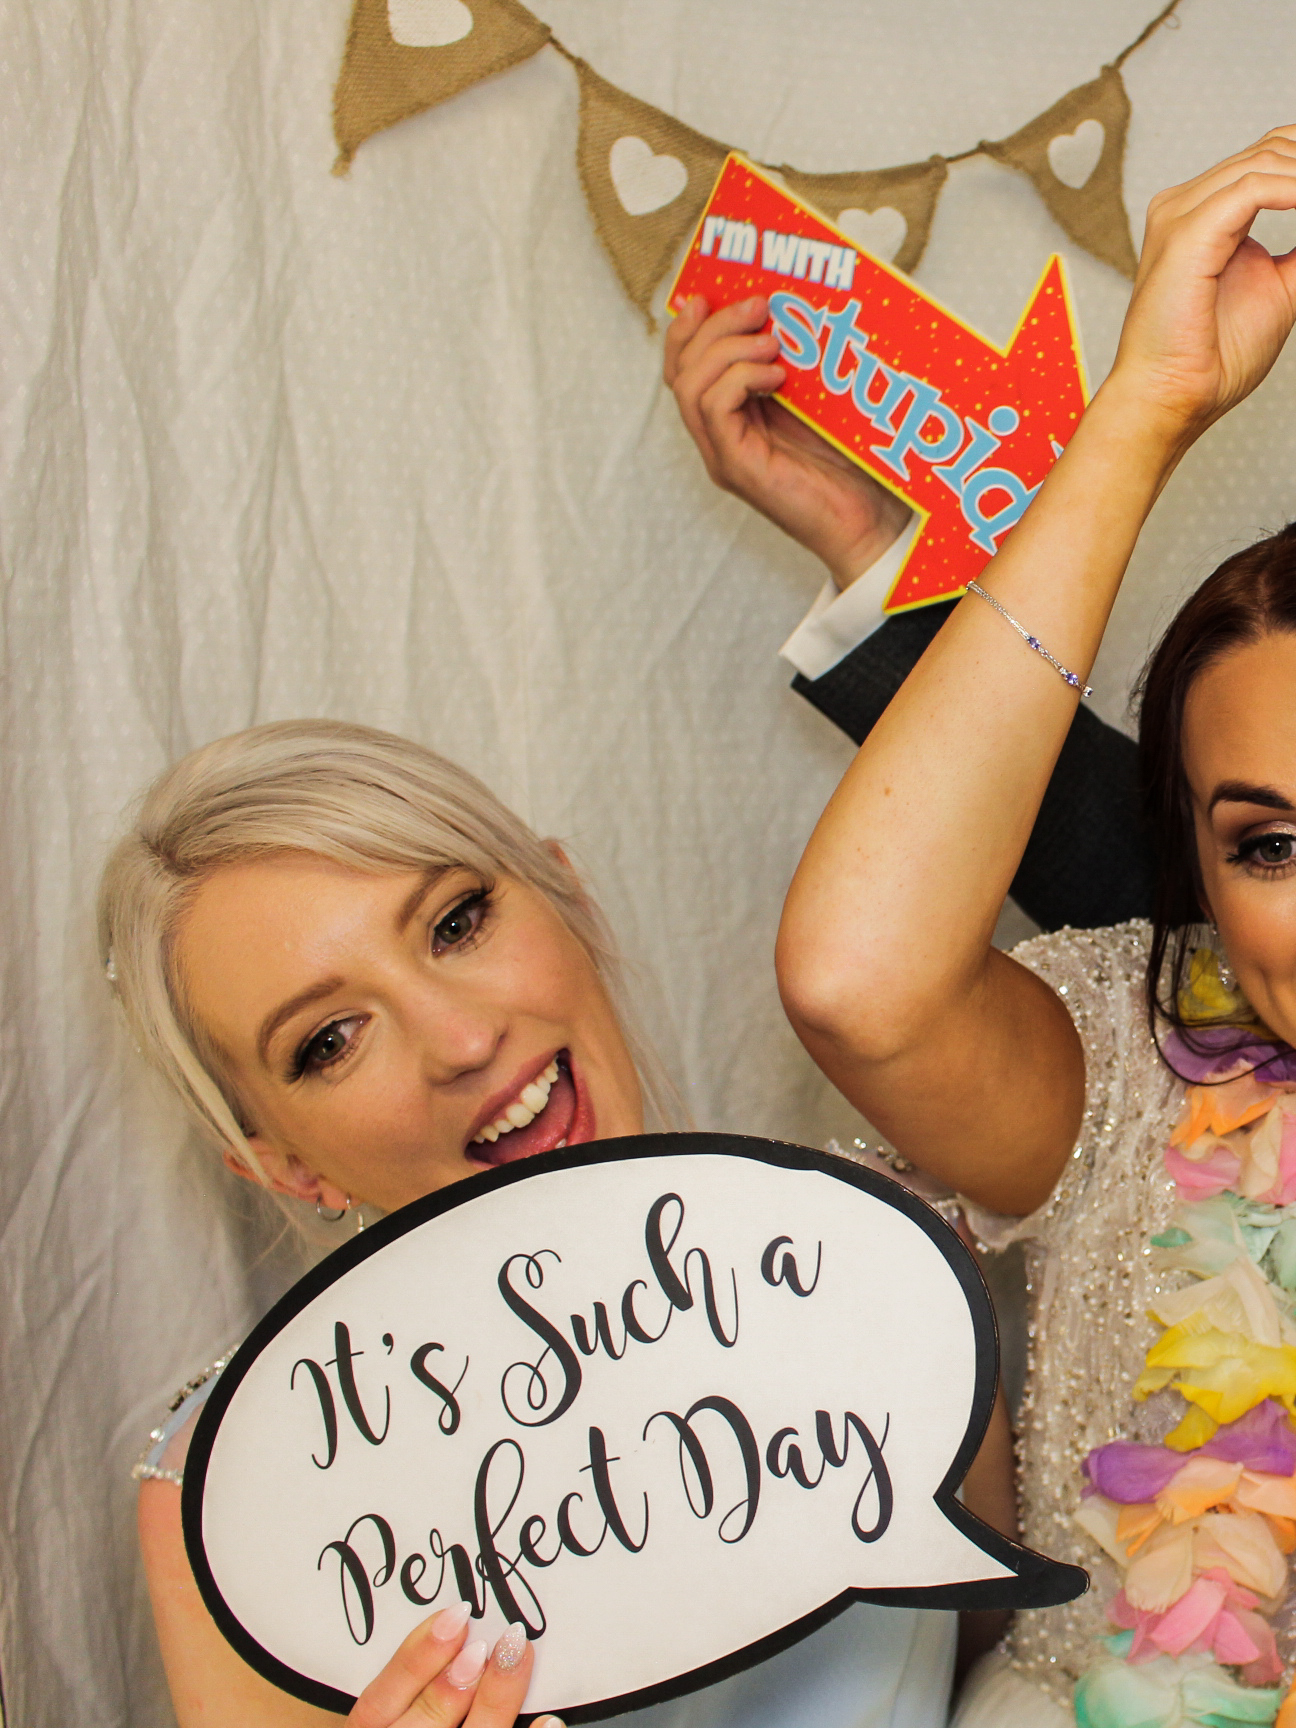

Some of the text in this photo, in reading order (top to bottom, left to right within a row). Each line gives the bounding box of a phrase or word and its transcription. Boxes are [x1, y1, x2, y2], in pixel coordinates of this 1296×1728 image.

[761, 230, 857, 292] WITH
[290, 1192, 822, 1470] It's Such a
[317, 1395, 894, 1646] Perfect Day
